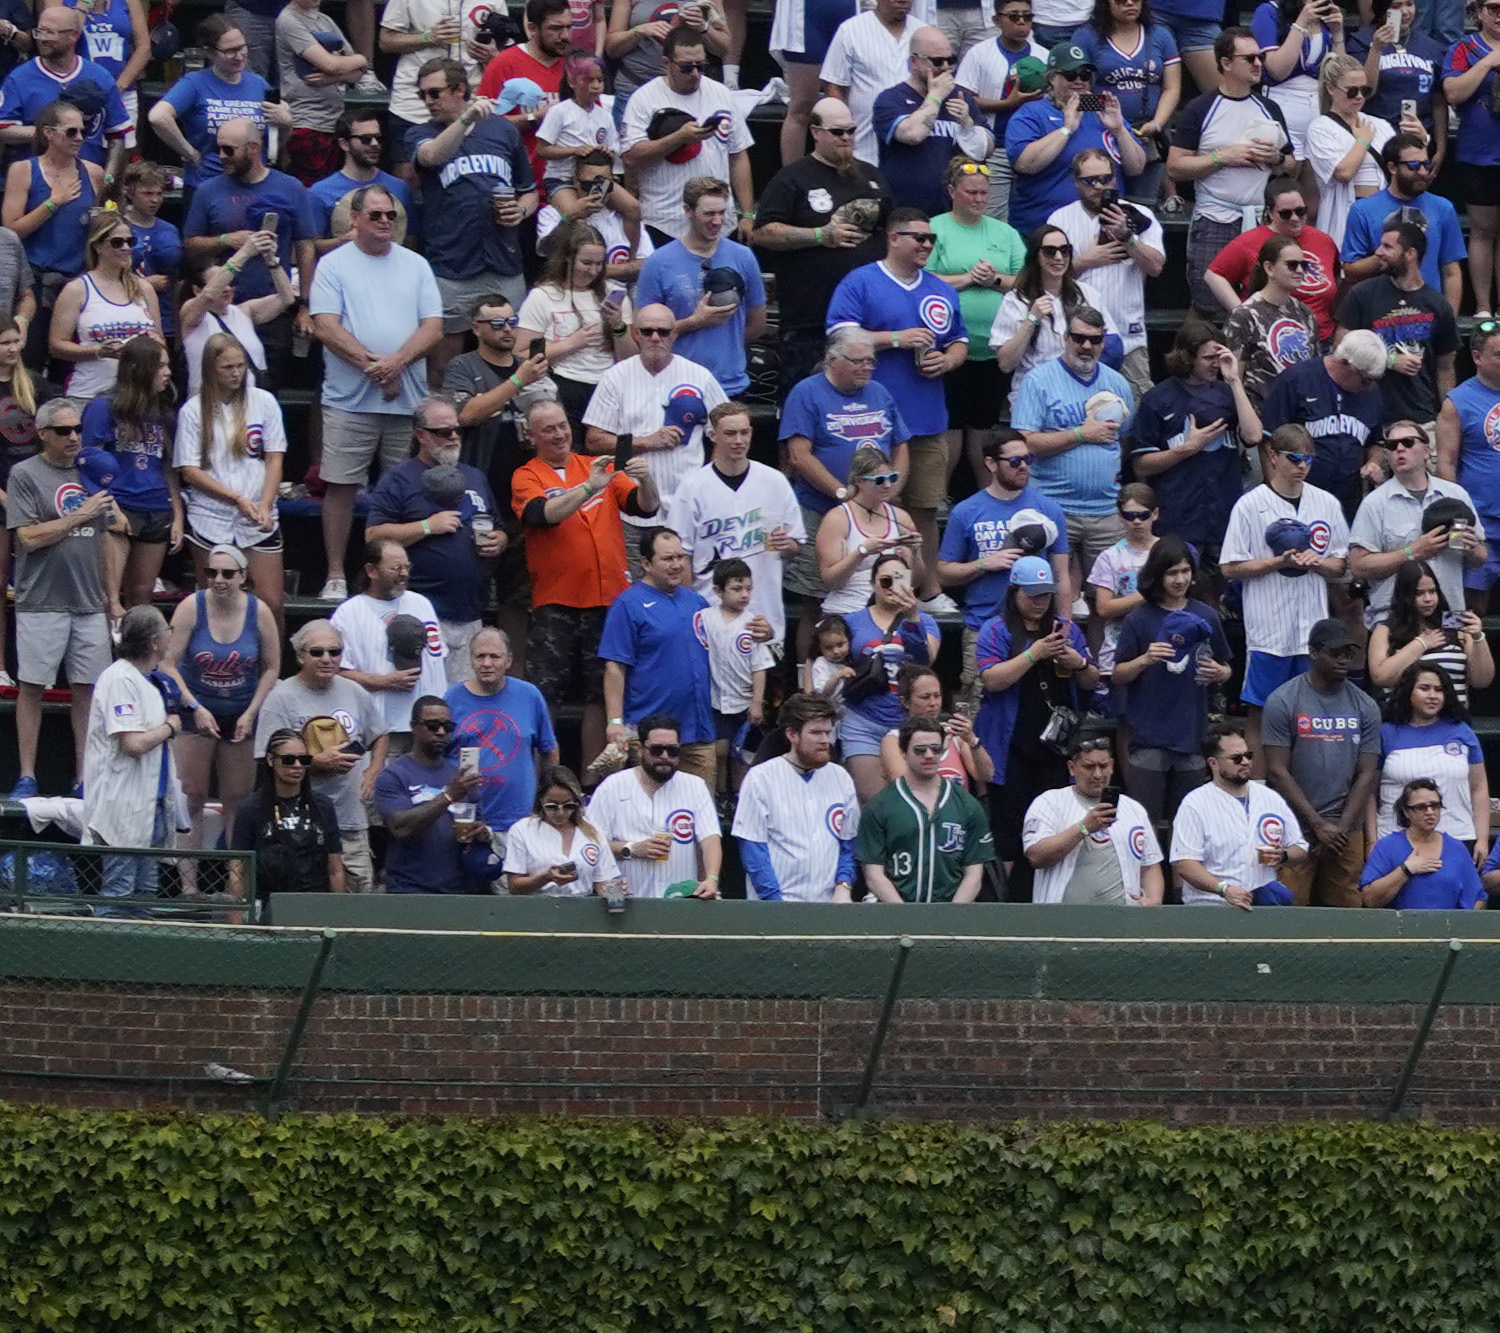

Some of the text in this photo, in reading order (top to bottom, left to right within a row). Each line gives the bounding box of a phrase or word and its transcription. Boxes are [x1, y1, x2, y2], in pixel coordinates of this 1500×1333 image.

[973, 521, 995, 532] IT'S
[975, 532, 998, 542] DAY
[1311, 716, 1359, 731] CUBS
[892, 851, 912, 876] 13
